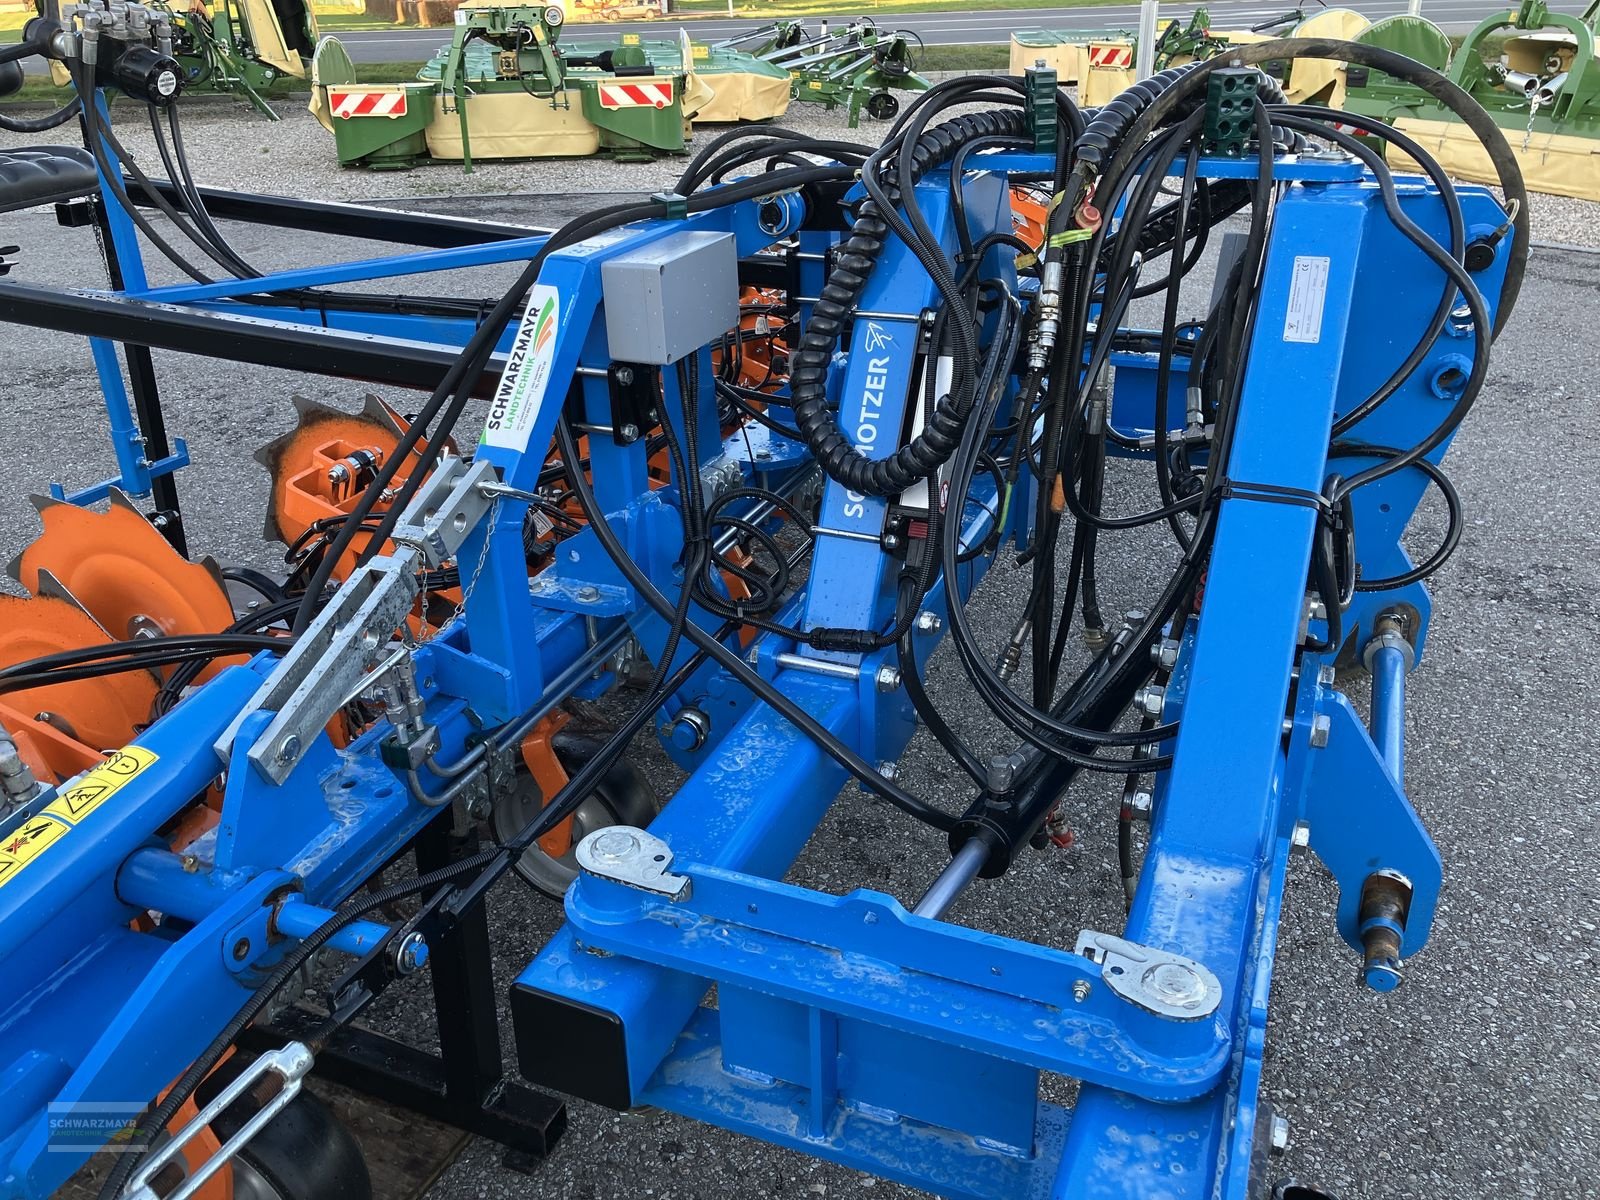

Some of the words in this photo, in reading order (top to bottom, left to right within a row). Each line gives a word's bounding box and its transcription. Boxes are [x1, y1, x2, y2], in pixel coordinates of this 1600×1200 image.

[488, 306, 541, 431] SCHWARZMAYR
[504, 356, 536, 430] LANDTECHNIK
[843, 356, 890, 519] SCMOTZER
